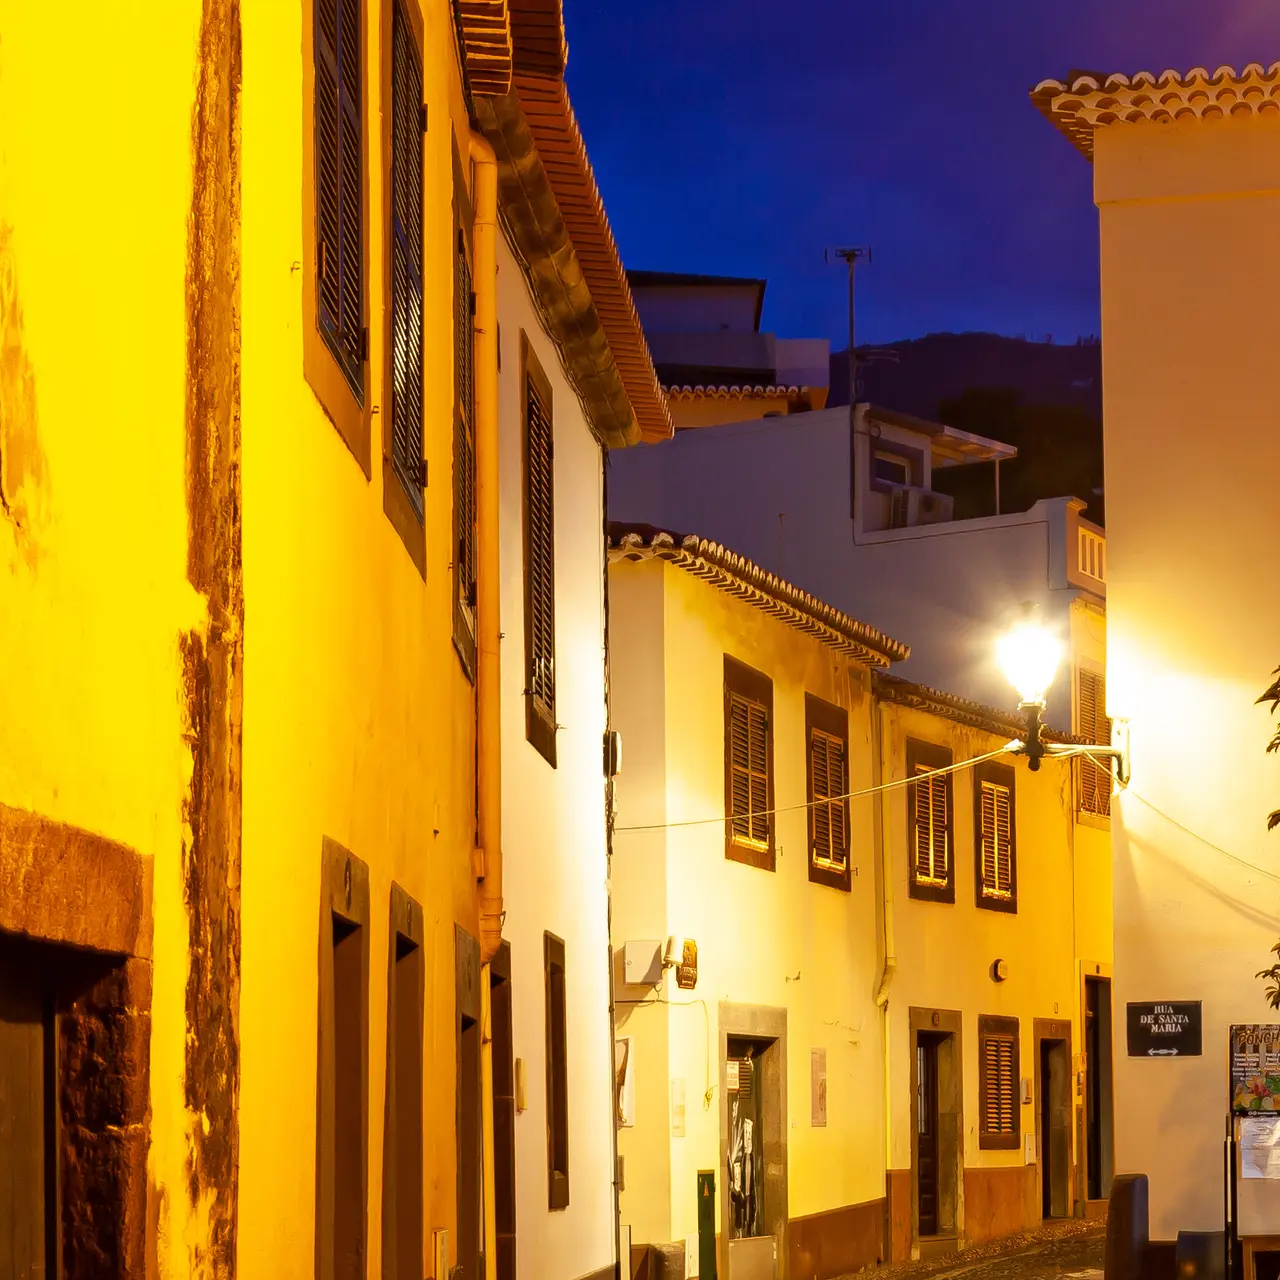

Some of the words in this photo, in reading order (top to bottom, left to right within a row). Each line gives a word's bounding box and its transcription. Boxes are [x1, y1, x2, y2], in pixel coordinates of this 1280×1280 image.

[1154, 1005, 1174, 1014] RUA
[1140, 1014, 1155, 1024] DE
[1158, 1014, 1190, 1024] SANTA
[1151, 1023, 1182, 1033] MARIA
